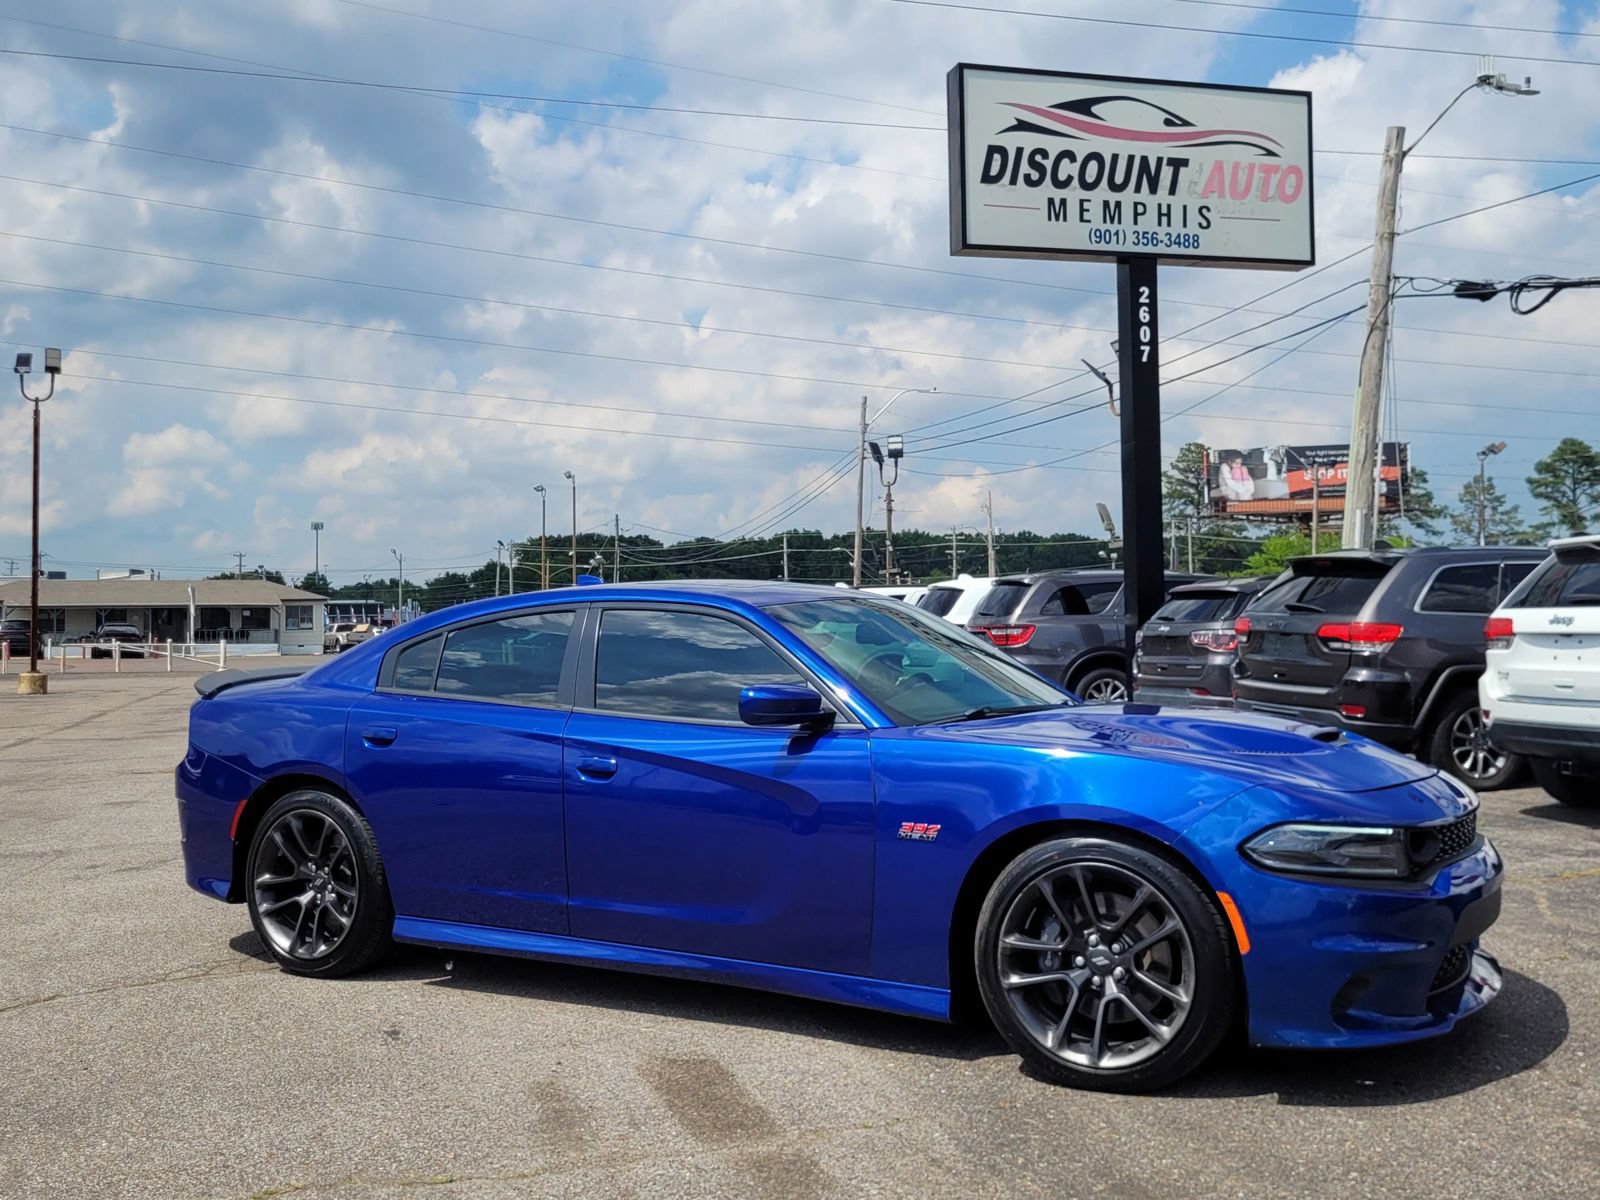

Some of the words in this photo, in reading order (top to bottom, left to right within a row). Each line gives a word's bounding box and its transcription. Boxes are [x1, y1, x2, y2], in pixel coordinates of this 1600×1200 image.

[980, 144, 1190, 197] DISCOUNT
[1200, 159, 1304, 204] AUTO
[1047, 197, 1211, 230] MEMPHIS
[1088, 227, 1127, 247] (901)
[1131, 230, 1200, 250] 356-3488
[1138, 286, 1151, 362] 2607
[1303, 467, 1335, 480] SOP
[899, 821, 941, 835] 392
